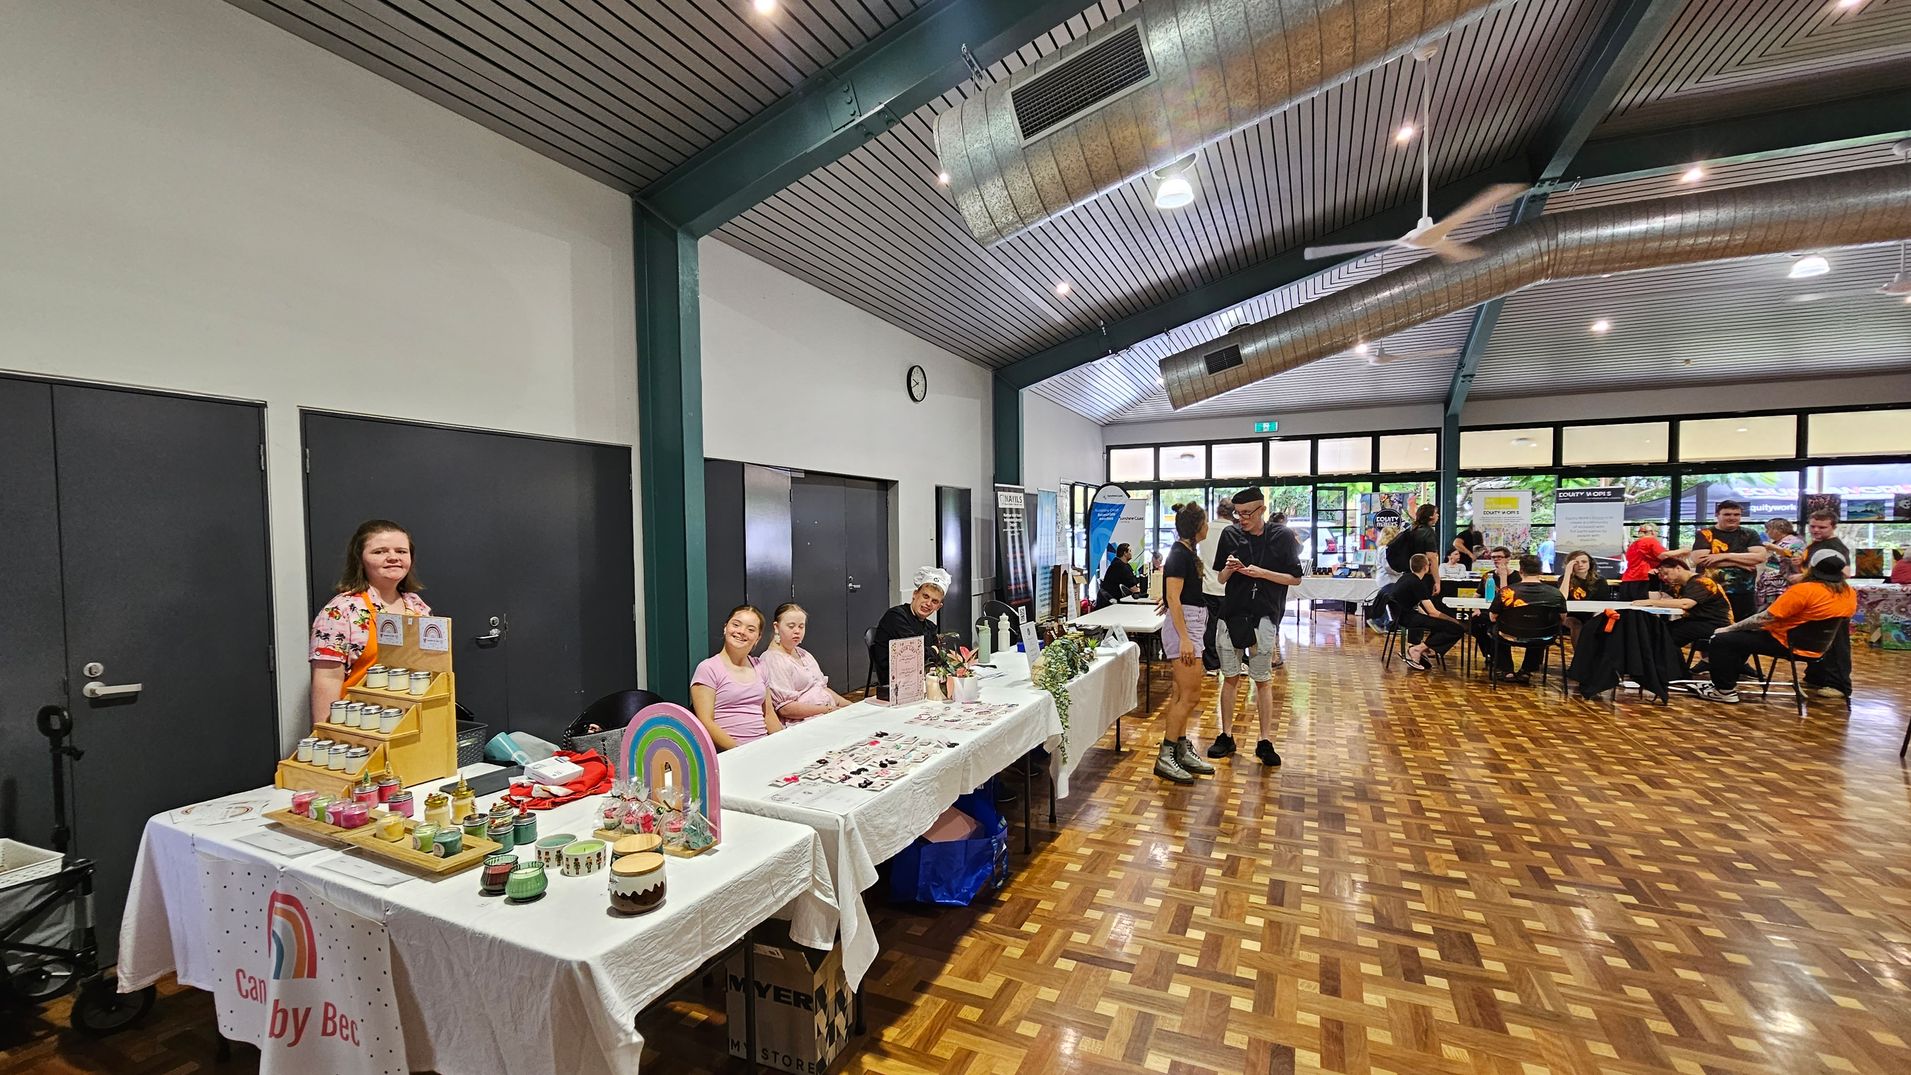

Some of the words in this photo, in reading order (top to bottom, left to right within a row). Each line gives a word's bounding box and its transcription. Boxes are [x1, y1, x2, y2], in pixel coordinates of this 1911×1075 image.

[729, 974, 814, 1012] MYER
[268, 998, 313, 1048] by
[320, 1001, 360, 1047] Bec
[760, 1048, 816, 1074] STORE
